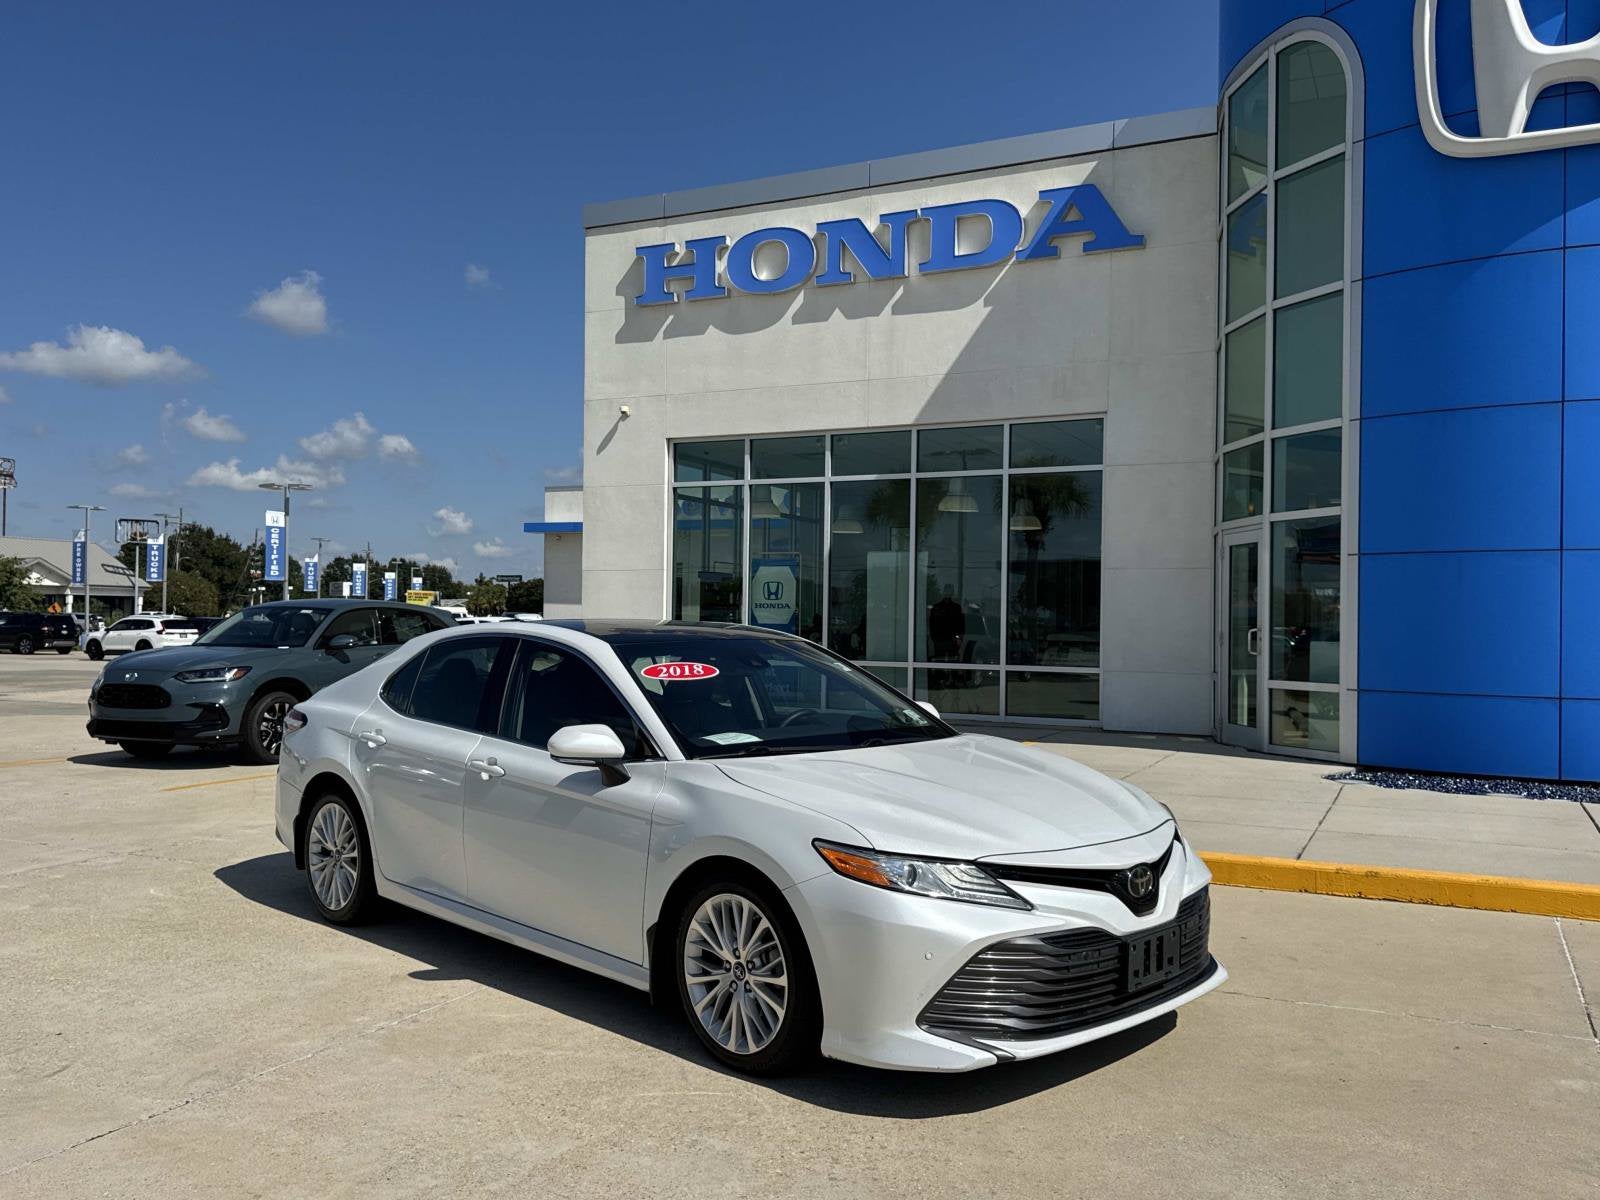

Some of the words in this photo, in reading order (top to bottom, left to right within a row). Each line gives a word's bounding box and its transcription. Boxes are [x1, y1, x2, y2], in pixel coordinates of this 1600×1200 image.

[635, 183, 1145, 306] HONDA
[150, 545, 159, 578] TRUCKS
[270, 527, 280, 576] CERTIFIED
[657, 664, 705, 678] 2018
